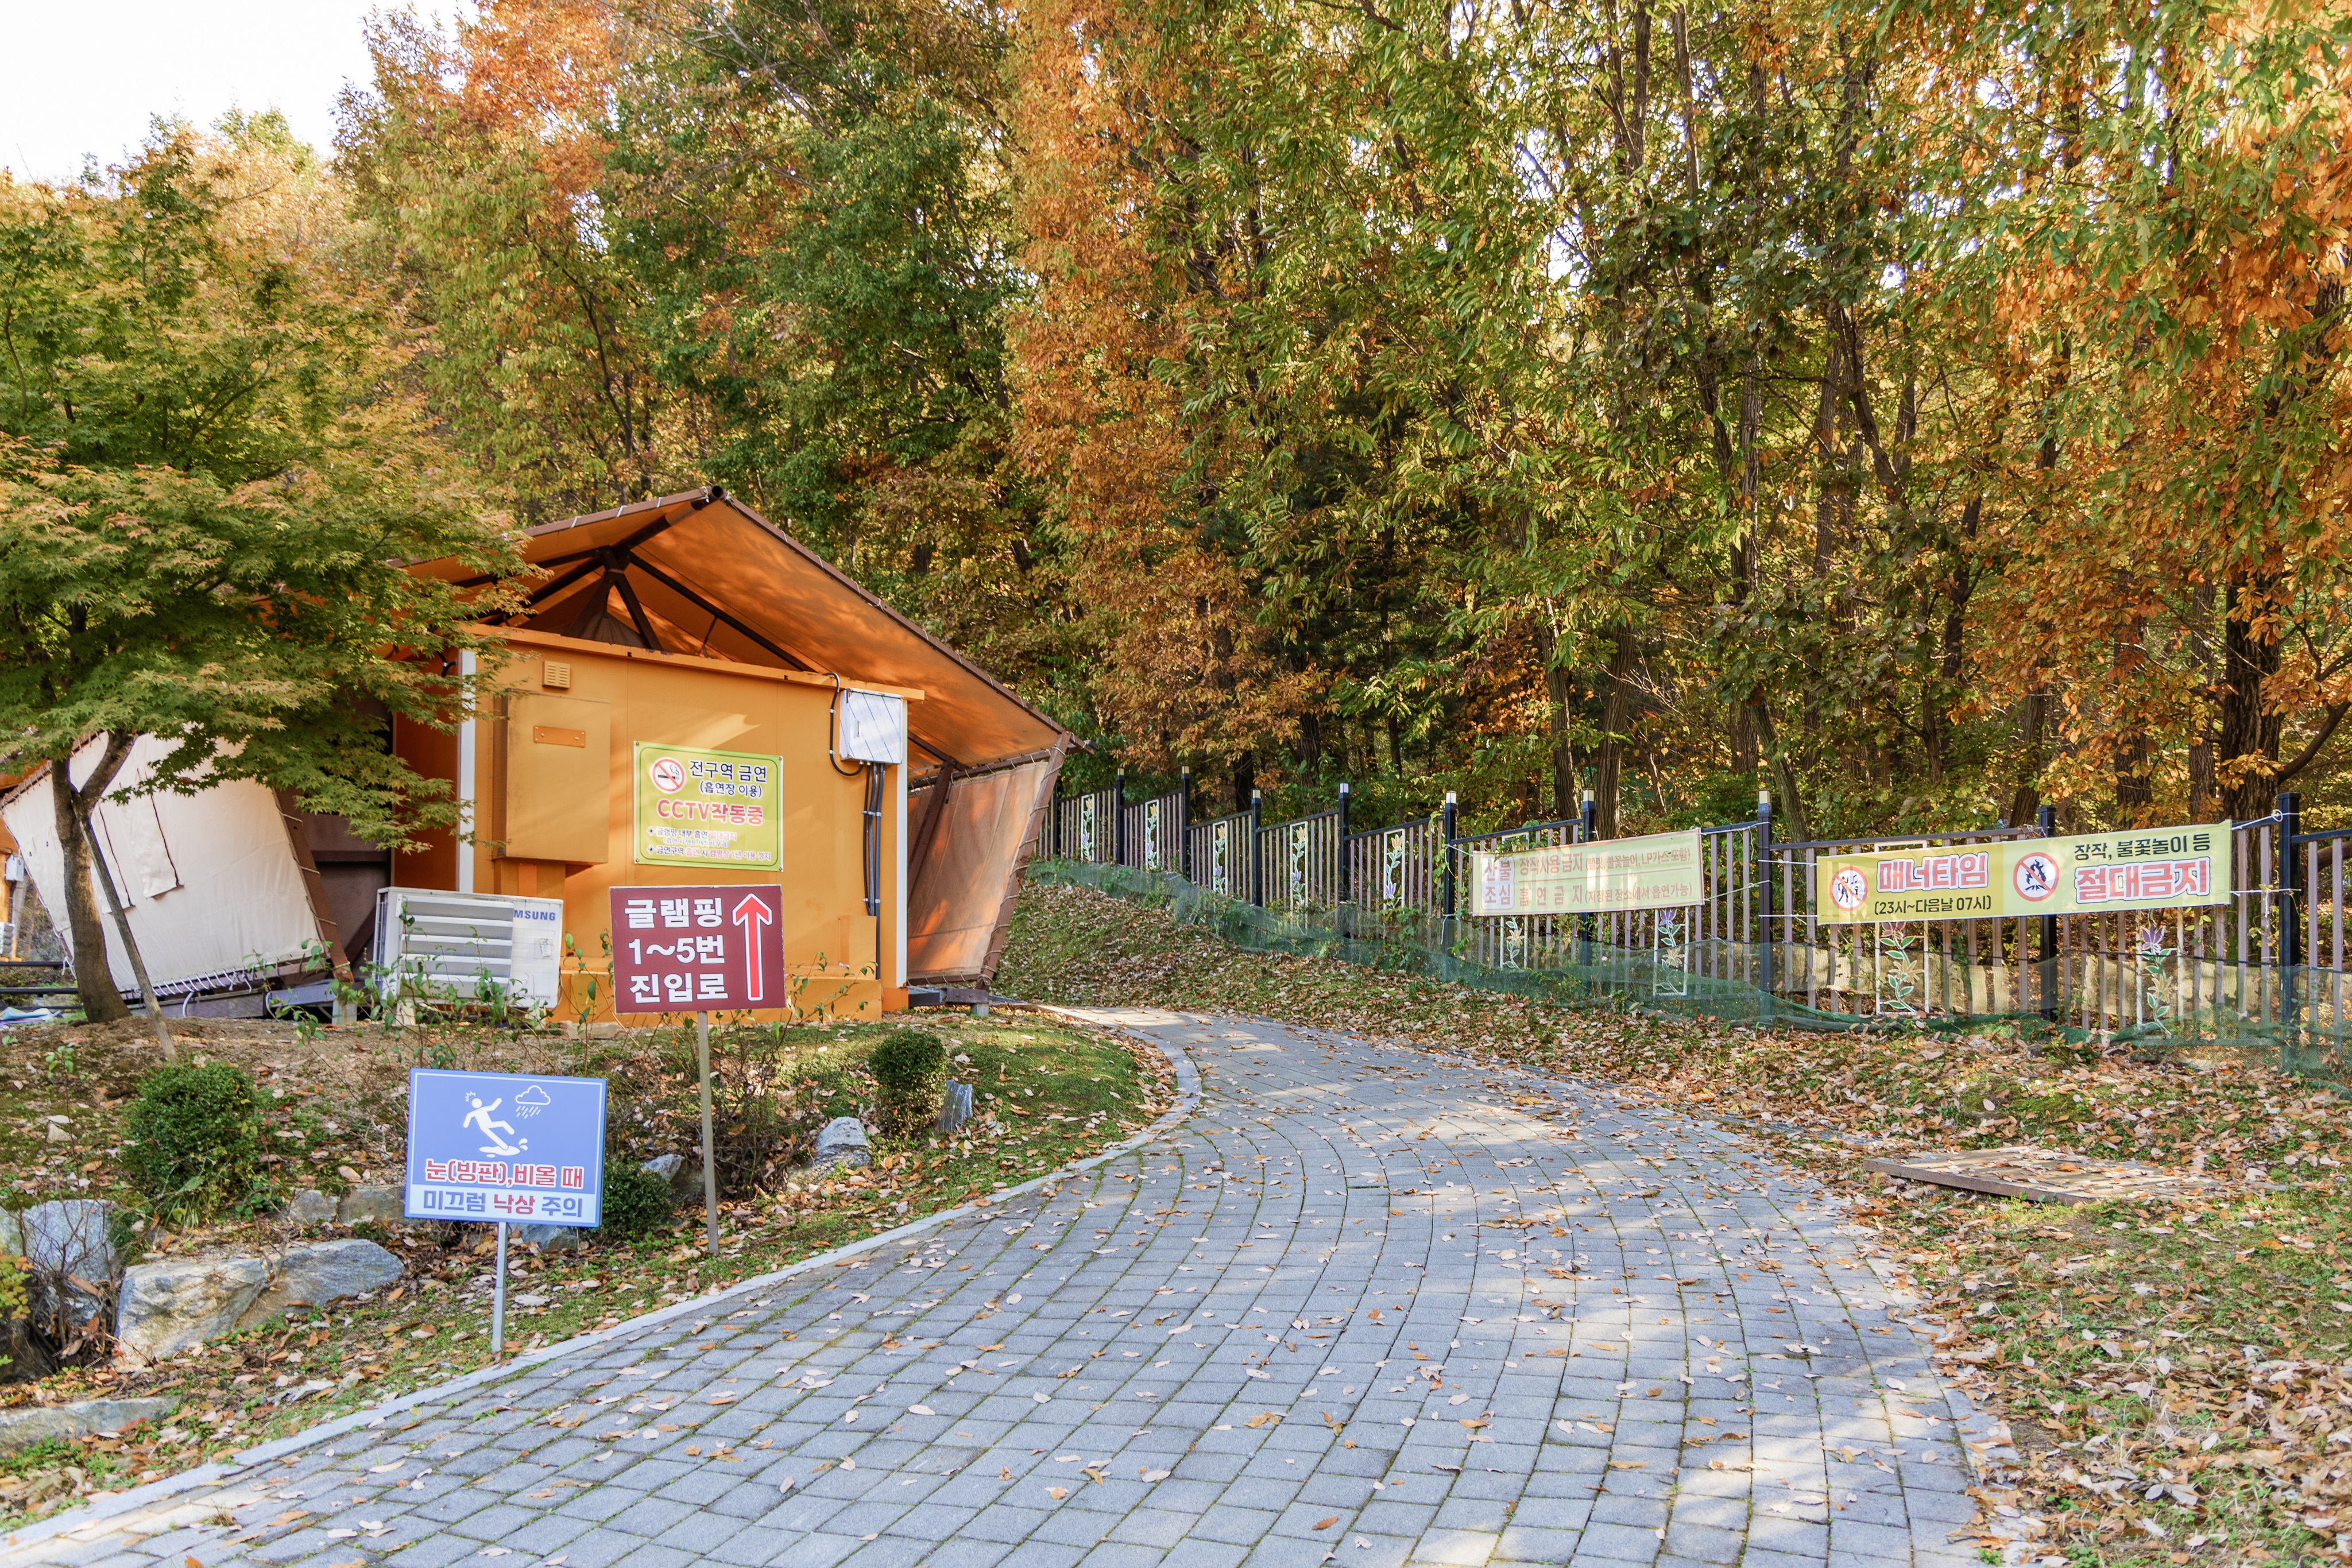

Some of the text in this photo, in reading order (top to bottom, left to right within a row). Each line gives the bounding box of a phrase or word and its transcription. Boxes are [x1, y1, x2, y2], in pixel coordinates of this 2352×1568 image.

[689, 761, 767, 783] 전구역 금연
[699, 780, 762, 798] (흡연장 이용)
[657, 799, 763, 824] CCTV작동중
[657, 827, 737, 841] 글램핑 내부 흡연 절대금지
[657, 846, 684, 855] 금연구역
[687, 847, 699, 857] 흡연
[710, 850, 729, 858] 캠핑장
[732, 851, 741, 860] 1년
[743, 851, 756, 860] 이용
[758, 852, 771, 861] 정지
[2074, 833, 2210, 861] 장작, 불꽃놀이 등
[1484, 860, 1511, 881] 산불
[1519, 852, 1582, 876] 장작사용금지
[1607, 853, 1641, 869] 불꽃놀이,
[1878, 854, 1987, 891] 매너타임
[2076, 859, 2208, 901] 절대금지
[1484, 884, 1511, 905] 조심
[1585, 889, 1612, 904] (지정된
[1615, 886, 1650, 901] 장소에서
[1653, 882, 1692, 899] 흡연가능)
[1874, 895, 1991, 915] (23시~다음날 07시)
[513, 909, 556, 921] MSUNG
[624, 897, 723, 928] 글램핑
[628, 935, 725, 965] 1~5번
[629, 973, 729, 1004] 진입로
[427, 1160, 583, 1187] 눈(빙판),비올 때
[423, 1190, 582, 1217] 미끄럼 낙상 주의
